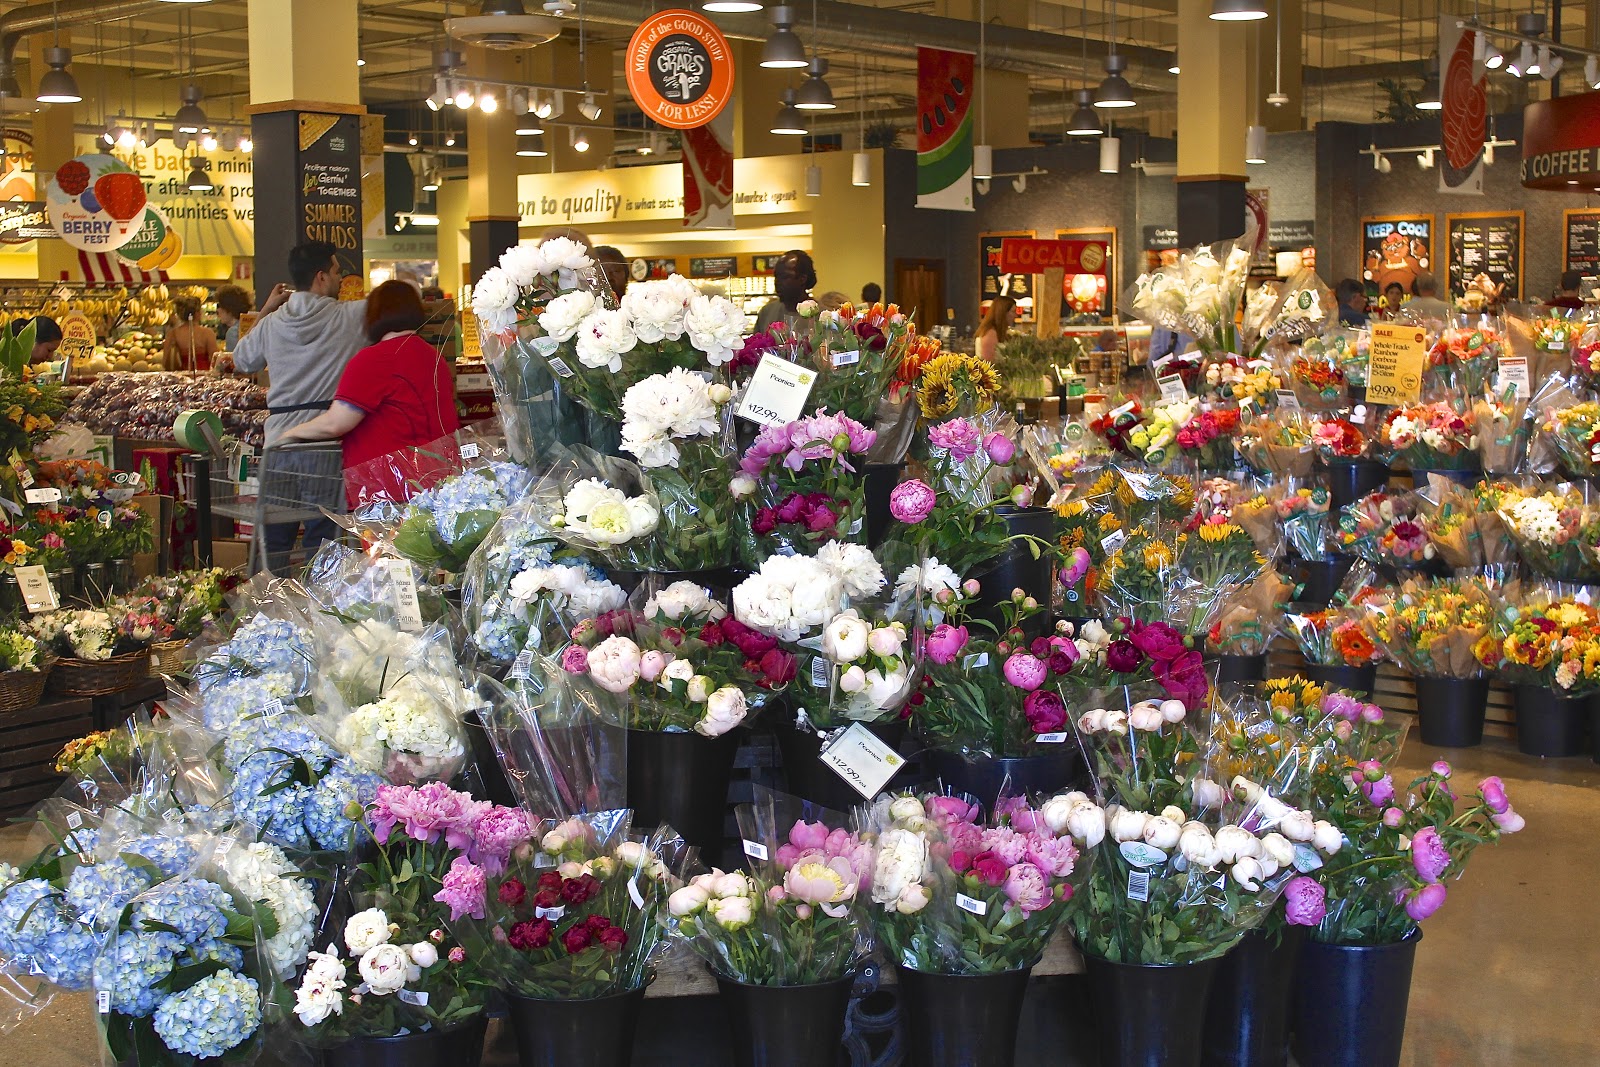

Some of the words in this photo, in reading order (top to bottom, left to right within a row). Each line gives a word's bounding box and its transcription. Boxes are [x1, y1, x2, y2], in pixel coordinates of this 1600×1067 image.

[636, 40, 650, 72] MORE
[648, 28, 659, 42] of
[656, 22, 672, 34] the
[674, 20, 703, 36] GOOD
[702, 32, 724, 62] STUFF
[656, 102, 682, 120] FOR
[685, 94, 718, 120] LESS!
[1533, 148, 1590, 178] COFFEE
[303, 174, 318, 196] for
[541, 195, 558, 216] to
[562, 188, 622, 220] quality
[626, 200, 634, 211] is
[634, 198, 656, 210] what
[658, 198, 674, 210] sets
[734, 190, 768, 204] Market
[305, 203, 357, 224] SUMMER
[63, 221, 112, 234] BERRY
[306, 225, 358, 250] SALADS
[1366, 222, 1393, 239] KEEP
[1397, 222, 1428, 238] COOL
[84, 236, 110, 244] FEST
[1006, 244, 1077, 265] LOCAL
